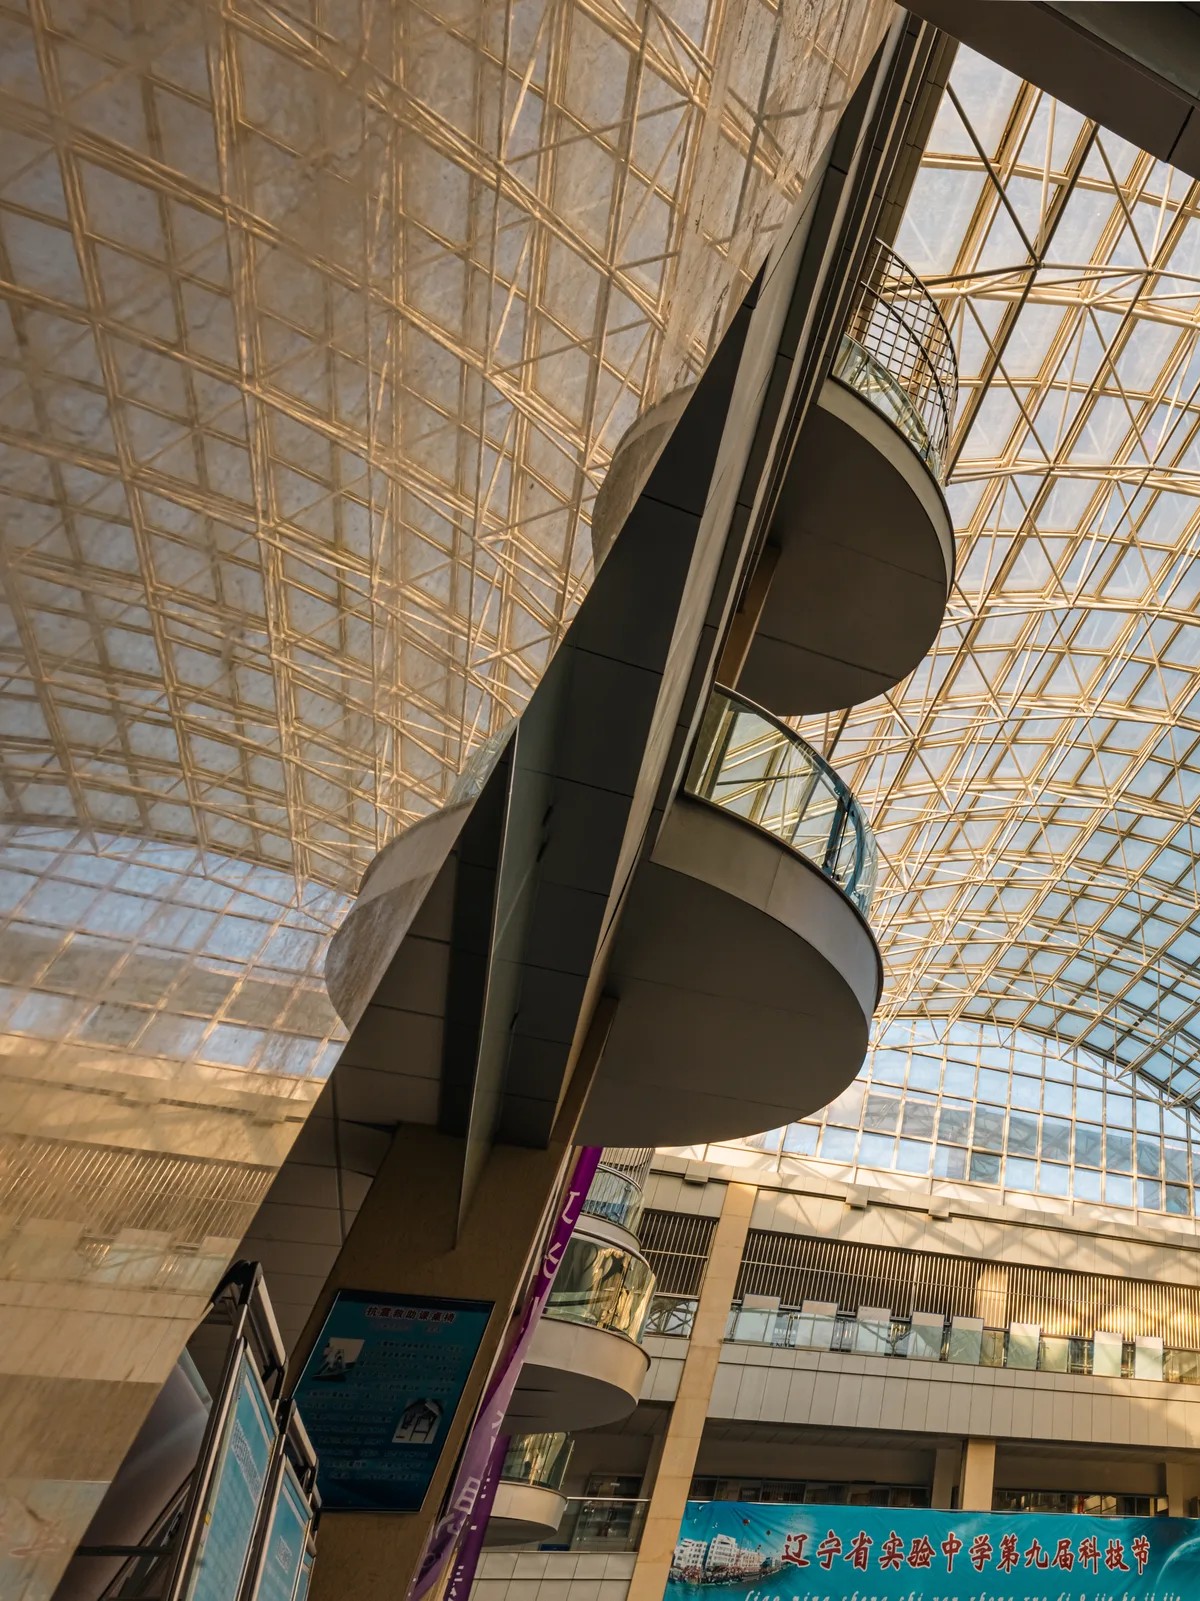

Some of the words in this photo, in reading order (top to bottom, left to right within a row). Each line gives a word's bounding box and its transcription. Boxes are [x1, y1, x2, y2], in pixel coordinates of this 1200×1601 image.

[366, 1306, 456, 1323] 抗震救助课桌椅
[781, 1529, 1149, 1575] 辽宁省实验中学第九届科技节
